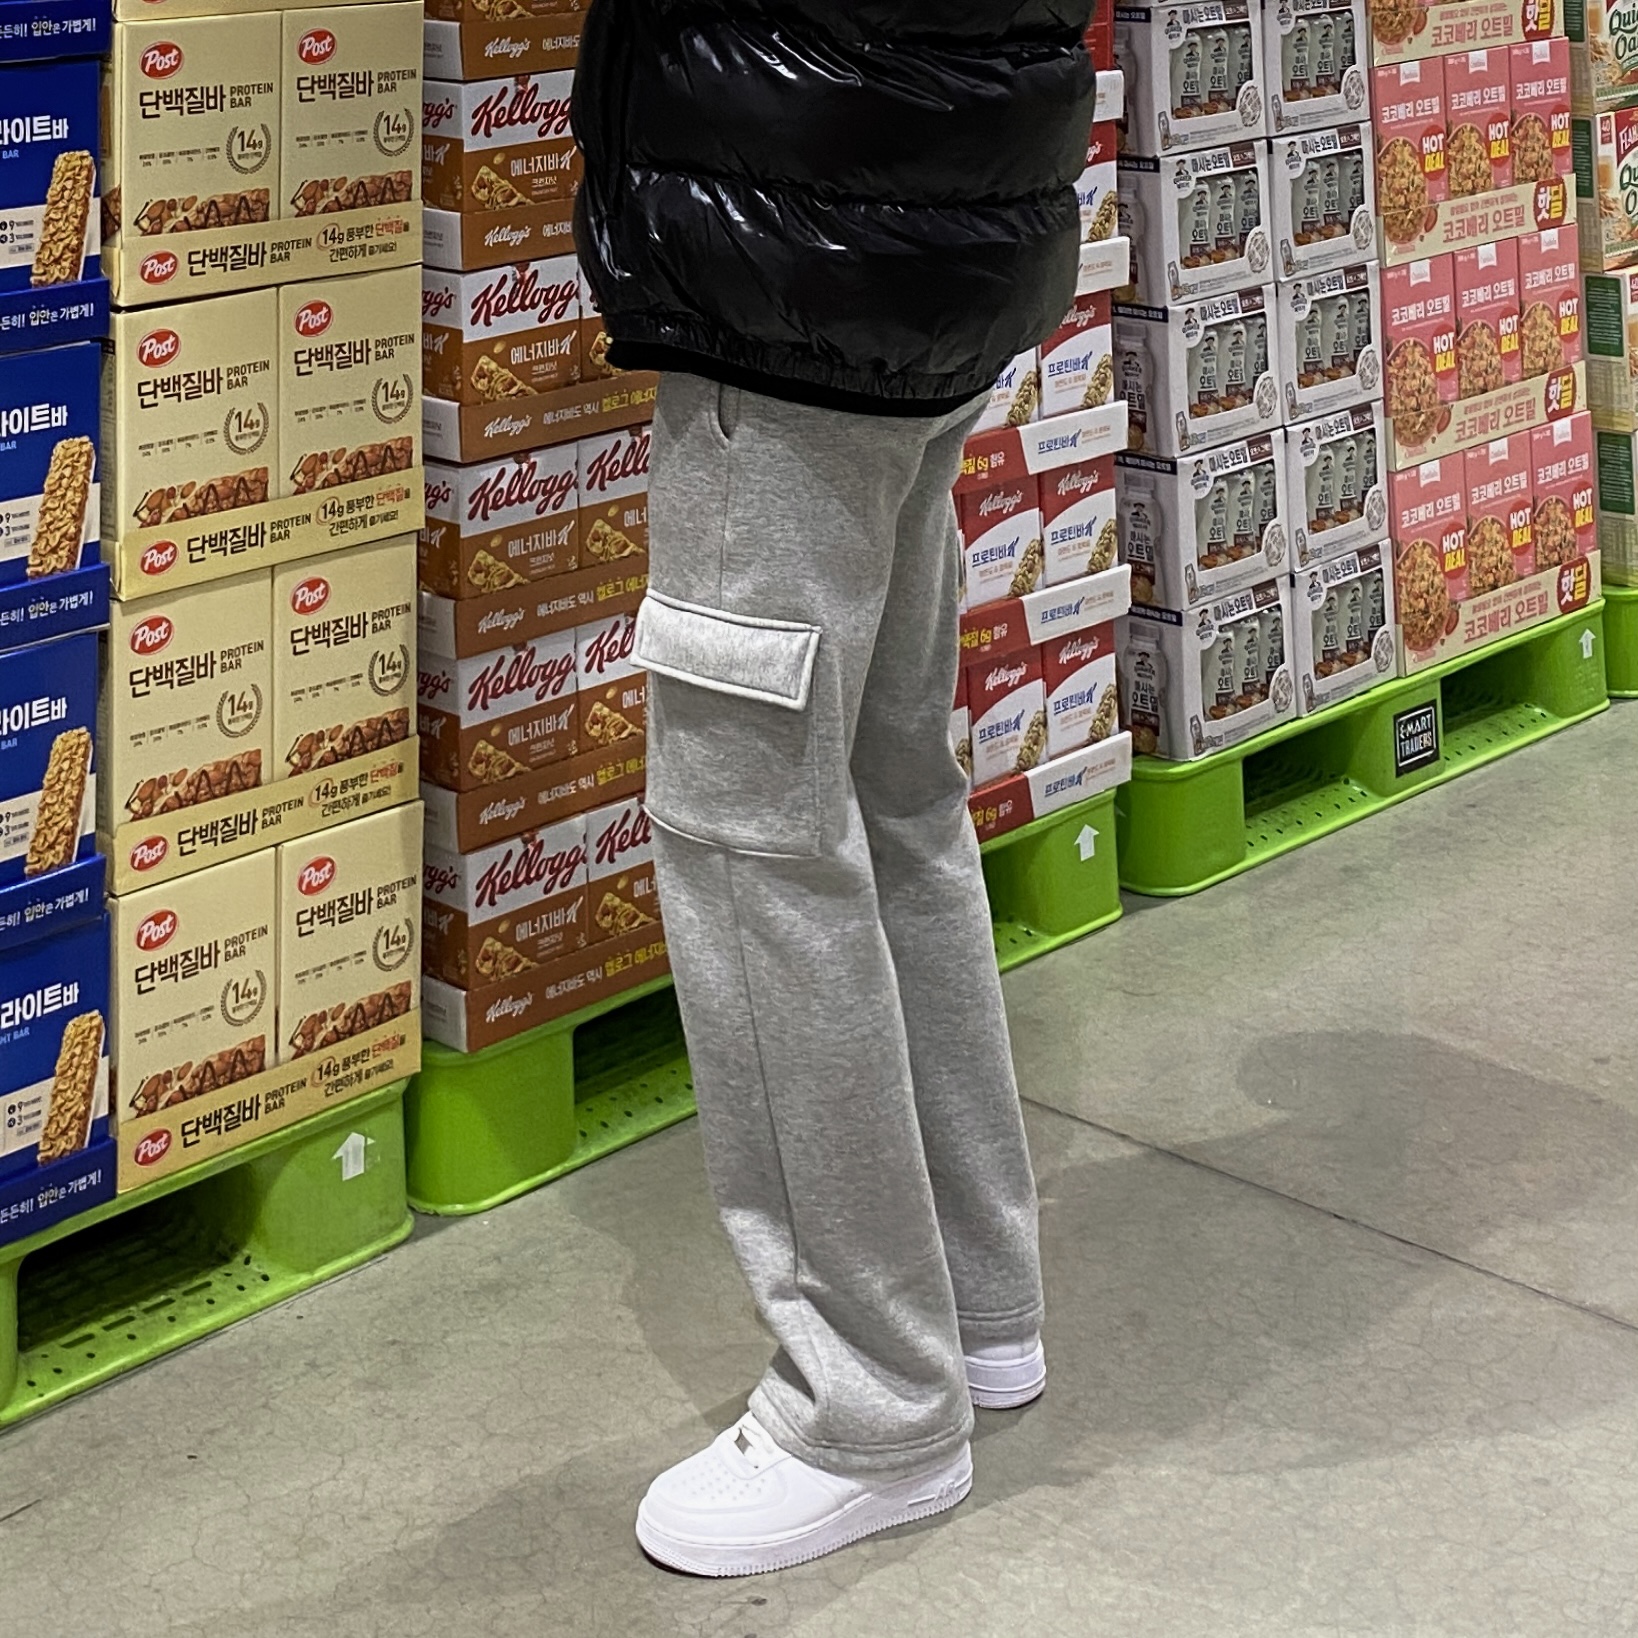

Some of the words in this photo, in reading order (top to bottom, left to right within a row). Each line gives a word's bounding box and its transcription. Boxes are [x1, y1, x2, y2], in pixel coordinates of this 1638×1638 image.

[31, 20, 61, 37] 입안은
[62, 18, 97, 33] 가볍게!
[1480, 14, 1513, 37] 오트밀
[302, 35, 333, 58] Post
[484, 36, 531, 59] Kellogg's
[144, 48, 179, 73] Post
[377, 69, 417, 82] PROTEIN
[230, 82, 274, 97] PROTEIN
[297, 71, 374, 103] 단백질바
[377, 81, 397, 94] BAR
[139, 84, 226, 119] 단백질바
[230, 96, 252, 109] BAR
[1415, 96, 1440, 117] 오트밀
[1488, 121, 1509, 139] HOT
[1551, 112, 1570, 130] HOT
[1422, 134, 1444, 154] HOT
[1490, 139, 1510, 158] DEAL
[1552, 129, 1570, 148] DEAL
[2, 149, 20, 159] BAR
[1424, 153, 1445, 173] DEAL
[1492, 205, 1525, 231] 오트밀
[271, 237, 312, 253] PROTEIN
[322, 227, 345, 246] 14g
[346, 224, 374, 242] 풍부한
[484, 223, 532, 247] Kellogg's
[187, 242, 267, 276] 단백질바
[270, 251, 291, 264] BAR
[329, 244, 367, 263] 간편하게
[142, 257, 175, 281] Post
[60, 303, 94, 322] 가볍게!
[1426, 295, 1450, 317] 오트밀
[1559, 299, 1578, 317] HOT
[298, 306, 329, 330] Post
[1499, 315, 1518, 335] HOT
[1560, 316, 1579, 335] DEAL
[141, 335, 176, 362] Post
[374, 333, 415, 349] PROTEIN
[1433, 332, 1454, 353] HOT
[1501, 334, 1520, 354] DEAL
[294, 337, 372, 377] 단백질바
[375, 348, 394, 361] BAR
[1435, 352, 1456, 372] DEAL
[226, 359, 270, 378] PROTEIN
[138, 366, 223, 409] 단백질바
[227, 375, 248, 390] BAR
[1503, 398, 1536, 426] 오트밀
[484, 414, 533, 438] Kellogg's
[1567, 452, 1589, 473] 오트밀
[1057, 470, 1099, 496] Kellogg's
[1504, 471, 1527, 494] 오트밀
[320, 500, 345, 521] 14g
[346, 494, 374, 515] 풍부한
[978, 489, 1024, 516] Kellogg's
[1436, 492, 1461, 516] 오트밀
[1573, 488, 1593, 510] HOT
[270, 513, 312, 533] PROTEIN
[328, 517, 368, 537] 간편하게
[1510, 508, 1531, 530] HOT
[1574, 508, 1594, 529] DEAL
[187, 522, 266, 563] 단백질바
[270, 529, 291, 543] BAR
[1442, 530, 1465, 552] HOT
[1512, 527, 1532, 549] DEAL
[143, 546, 176, 571] Post
[1444, 550, 1466, 573] DEAL
[59, 591, 94, 610] 가볍게!
[293, 583, 327, 610] Post
[1514, 590, 1549, 624] 오트밀
[371, 601, 412, 622] PROTEIN
[478, 607, 526, 633] Kellogg's
[133, 621, 169, 650] Post
[290, 611, 369, 656] 단백질바
[371, 620, 392, 634] BAR
[220, 640, 265, 661] PROTEIN
[1058, 636, 1100, 664] Kellogg's
[129, 650, 217, 698] 단백질바
[220, 659, 242, 674] BAR
[985, 662, 1028, 691] Kellogg's
[1, 738, 18, 750] BAR
[1400, 731, 1432, 758] TRADERS
[313, 781, 338, 802] 14g
[262, 796, 305, 817] PROTEIN
[479, 797, 526, 825] Kellogg's
[177, 808, 260, 857] 단백질바
[261, 815, 283, 830] BAR
[132, 841, 166, 868] Post
[301, 862, 332, 892] Post
[376, 874, 417, 897] PROTEIN
[54, 888, 89, 910] 가볍게!
[376, 894, 397, 910] BAR
[295, 887, 373, 938] 단백질바
[139, 915, 174, 946] Post
[224, 925, 269, 951] PROTEIN
[224, 945, 246, 963] BAR
[134, 940, 221, 996] 단백질바
[485, 991, 534, 1023] Kellogg's
[316, 1062, 341, 1082] 14g
[265, 1077, 308, 1102] PROTEIN
[265, 1098, 286, 1115] BAR
[181, 1094, 262, 1149] 단백질바
[137, 1134, 170, 1163] Post
[37, 1187, 67, 1209] 입안은
[68, 1169, 102, 1194] 가볍게!
